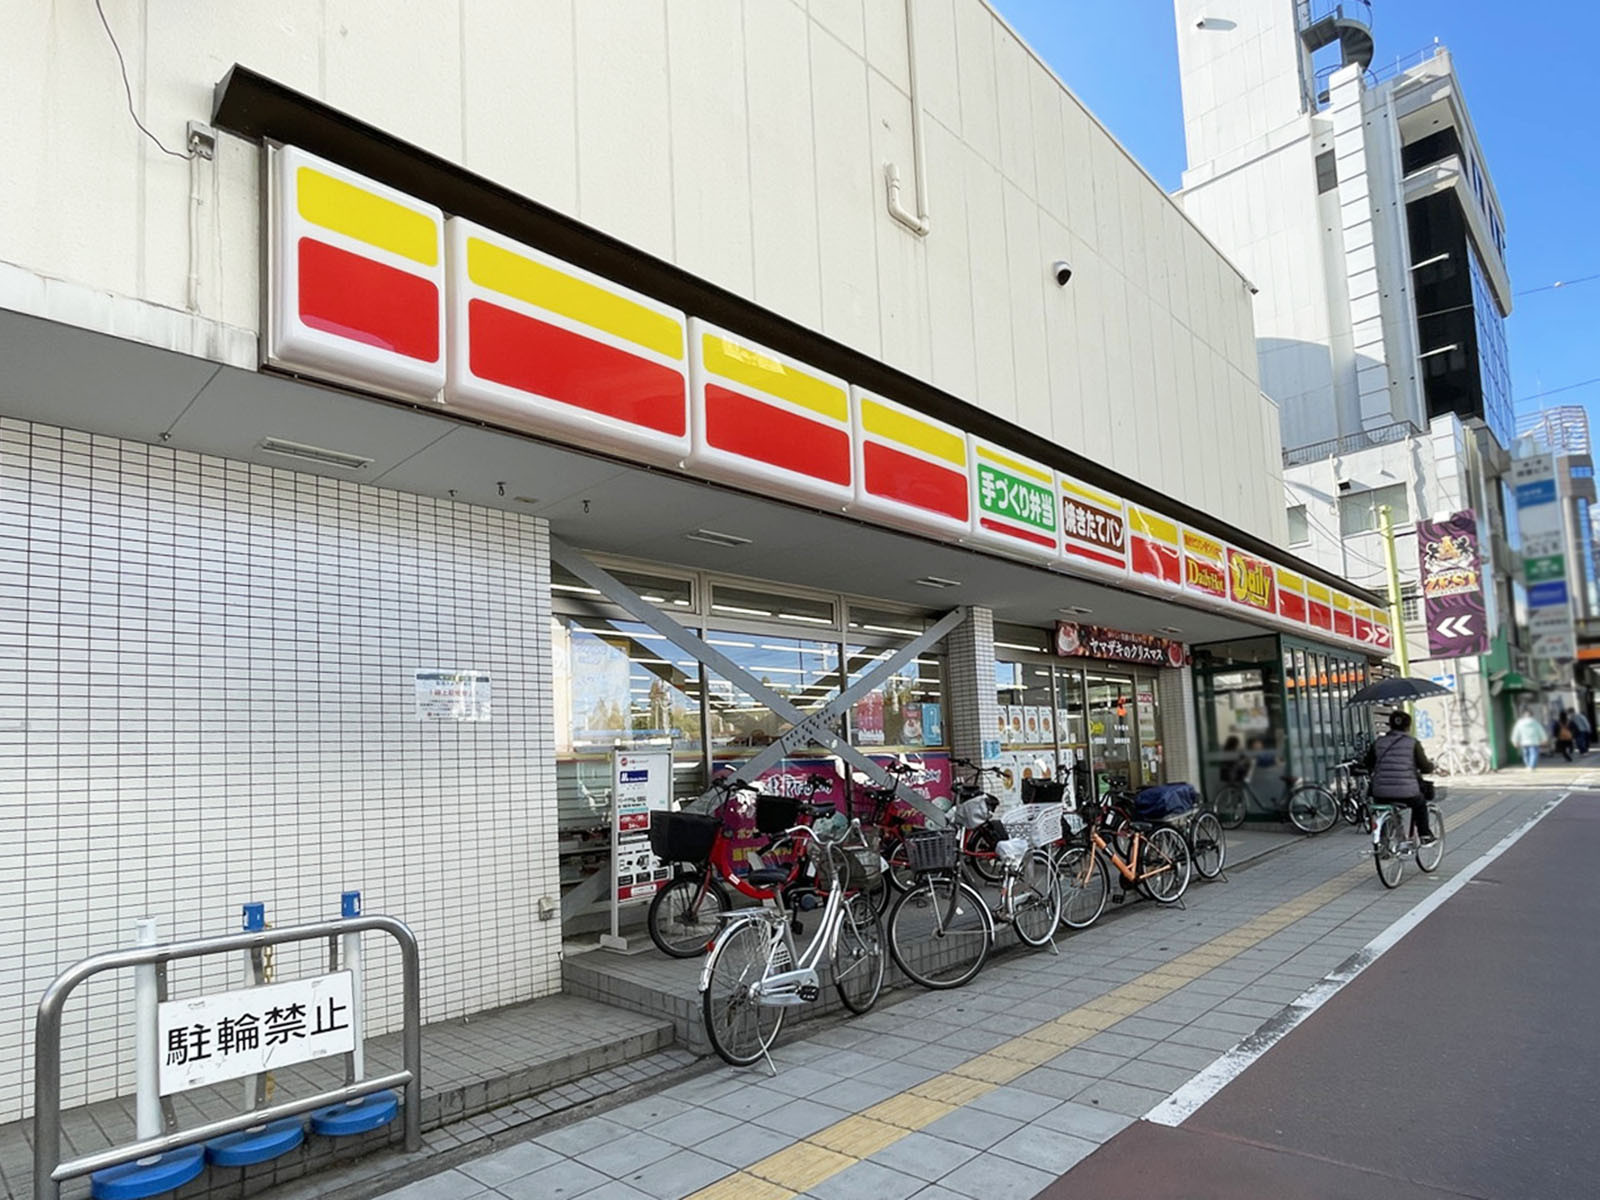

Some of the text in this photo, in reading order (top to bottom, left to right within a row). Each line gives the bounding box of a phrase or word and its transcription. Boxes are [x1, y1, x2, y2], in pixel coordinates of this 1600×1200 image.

[978, 471, 1054, 527] 手づくり弁当
[1064, 501, 1124, 547] 焼きたてパン
[1231, 552, 1270, 607] Daily
[1089, 638, 1164, 661] ヤマザキのクリスマス
[165, 996, 349, 1066] 駐輪禁止
